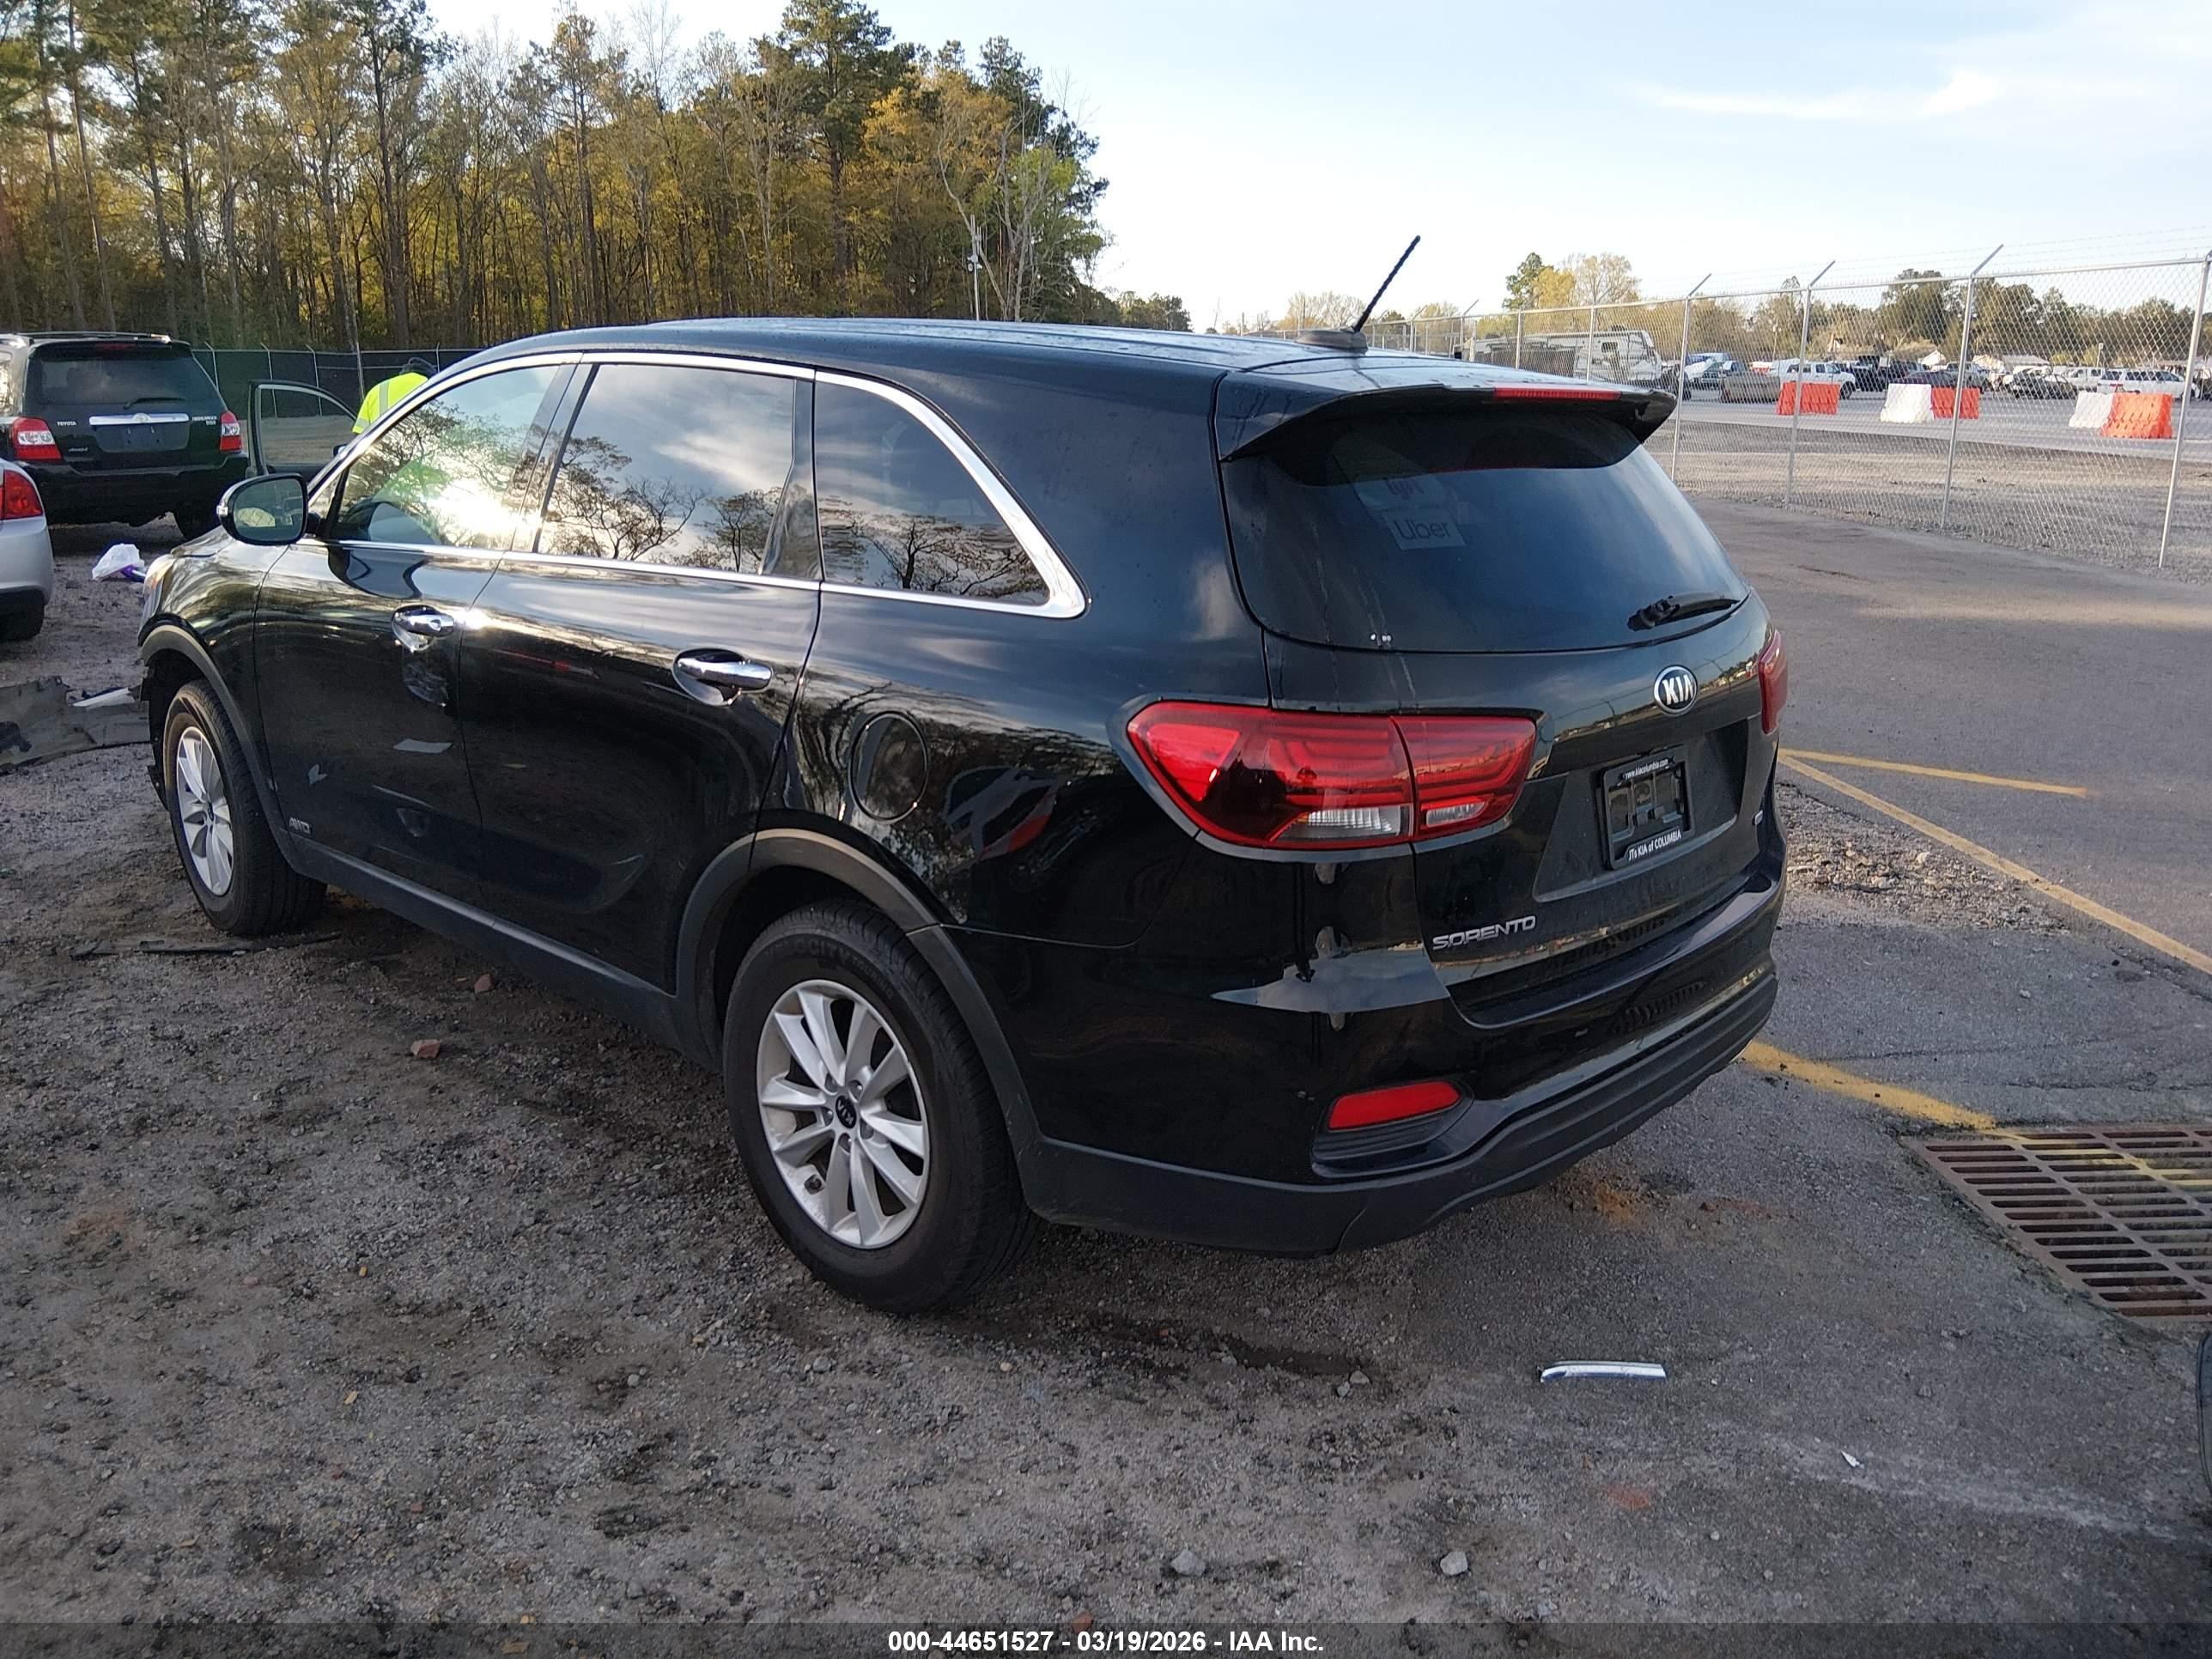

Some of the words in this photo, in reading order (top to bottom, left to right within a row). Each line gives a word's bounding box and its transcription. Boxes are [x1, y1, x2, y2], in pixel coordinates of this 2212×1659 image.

[1394, 519, 1451, 540] Uber
[1662, 674, 1694, 706] KIA
[289, 817, 311, 835] AWD
[1638, 843, 1648, 857] KIA
[1648, 840, 1654, 853] of
[1654, 829, 1682, 849] COLUMBIA
[1432, 915, 1536, 951] SORENTO
